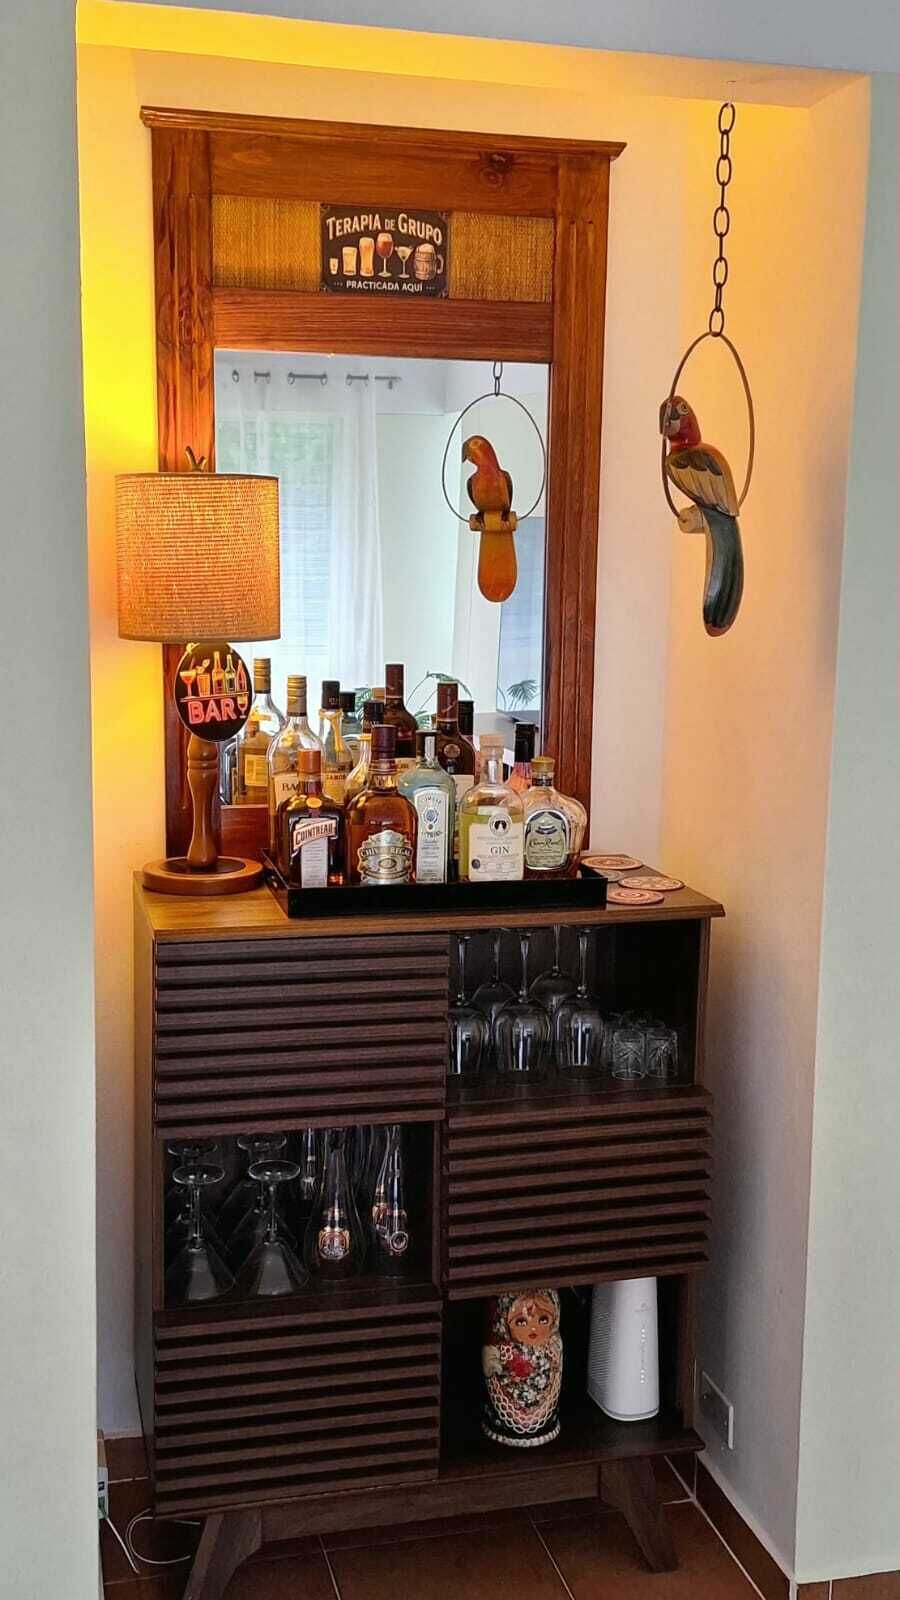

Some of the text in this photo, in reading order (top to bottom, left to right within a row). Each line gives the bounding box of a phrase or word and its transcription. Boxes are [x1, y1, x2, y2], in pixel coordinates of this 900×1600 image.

[326, 213, 442, 246] TERAPIA DE GRUPO
[346, 280, 399, 291] PRACTICADA
[188, 698, 237, 724] BAR
[295, 822, 333, 846] COINTREAU
[490, 846, 510, 856] GIN
